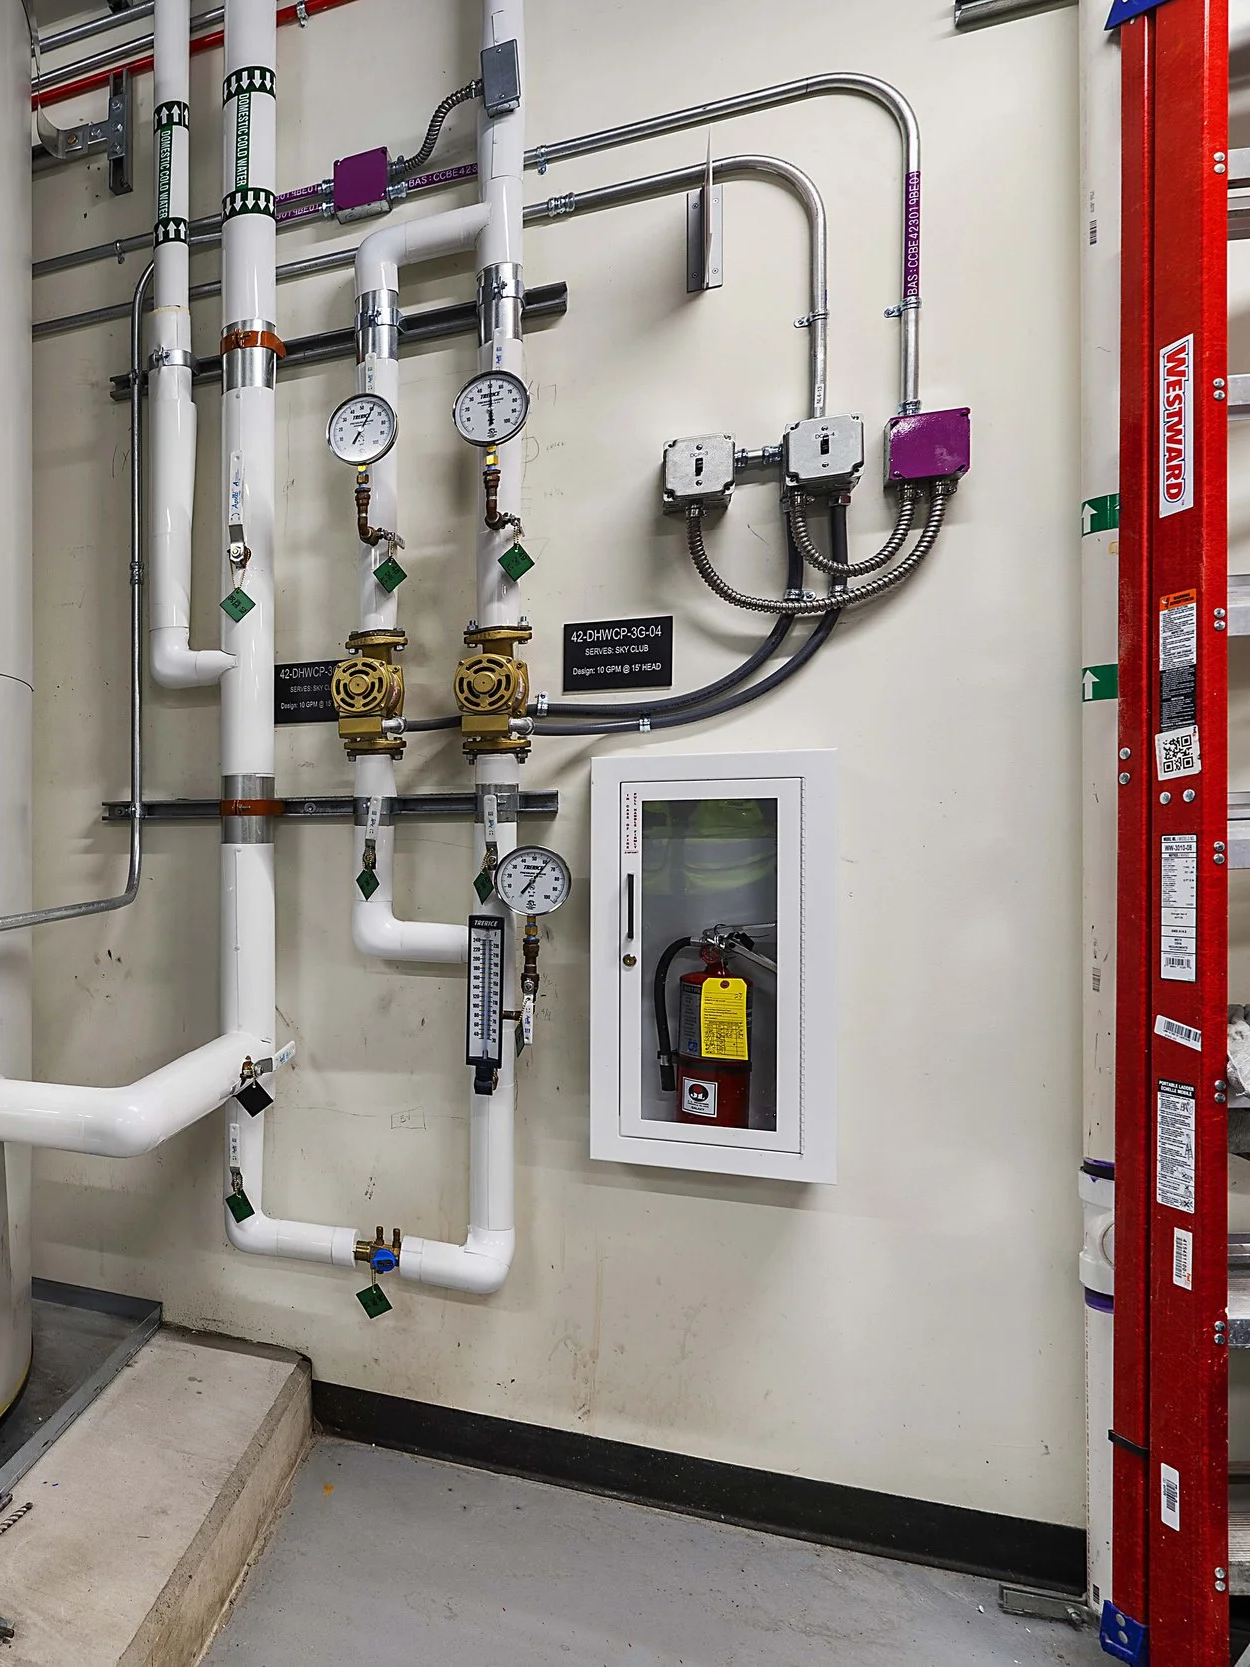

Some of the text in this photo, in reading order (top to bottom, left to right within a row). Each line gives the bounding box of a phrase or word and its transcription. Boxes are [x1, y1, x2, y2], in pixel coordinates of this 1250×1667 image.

[236, 92, 250, 187] DOMESTIC COLD WATER
[158, 130, 171, 220] DOMESTIC COLD WATER
[1165, 343, 1187, 502] WESTWARD
[570, 624, 662, 643] 42-DHWCP-3G-04
[585, 644, 649, 656] SERVES: SKY CLUB
[572, 667, 596, 676] Design:
[597, 666, 605, 674] 10
[605, 665, 622, 673] GPM
[622, 664, 630, 674] @
[641, 662, 662, 671] HEAD
[313, 684, 324, 692] SKY
[305, 700, 318, 708] GPM
[474, 919, 498, 927] TRERICE
